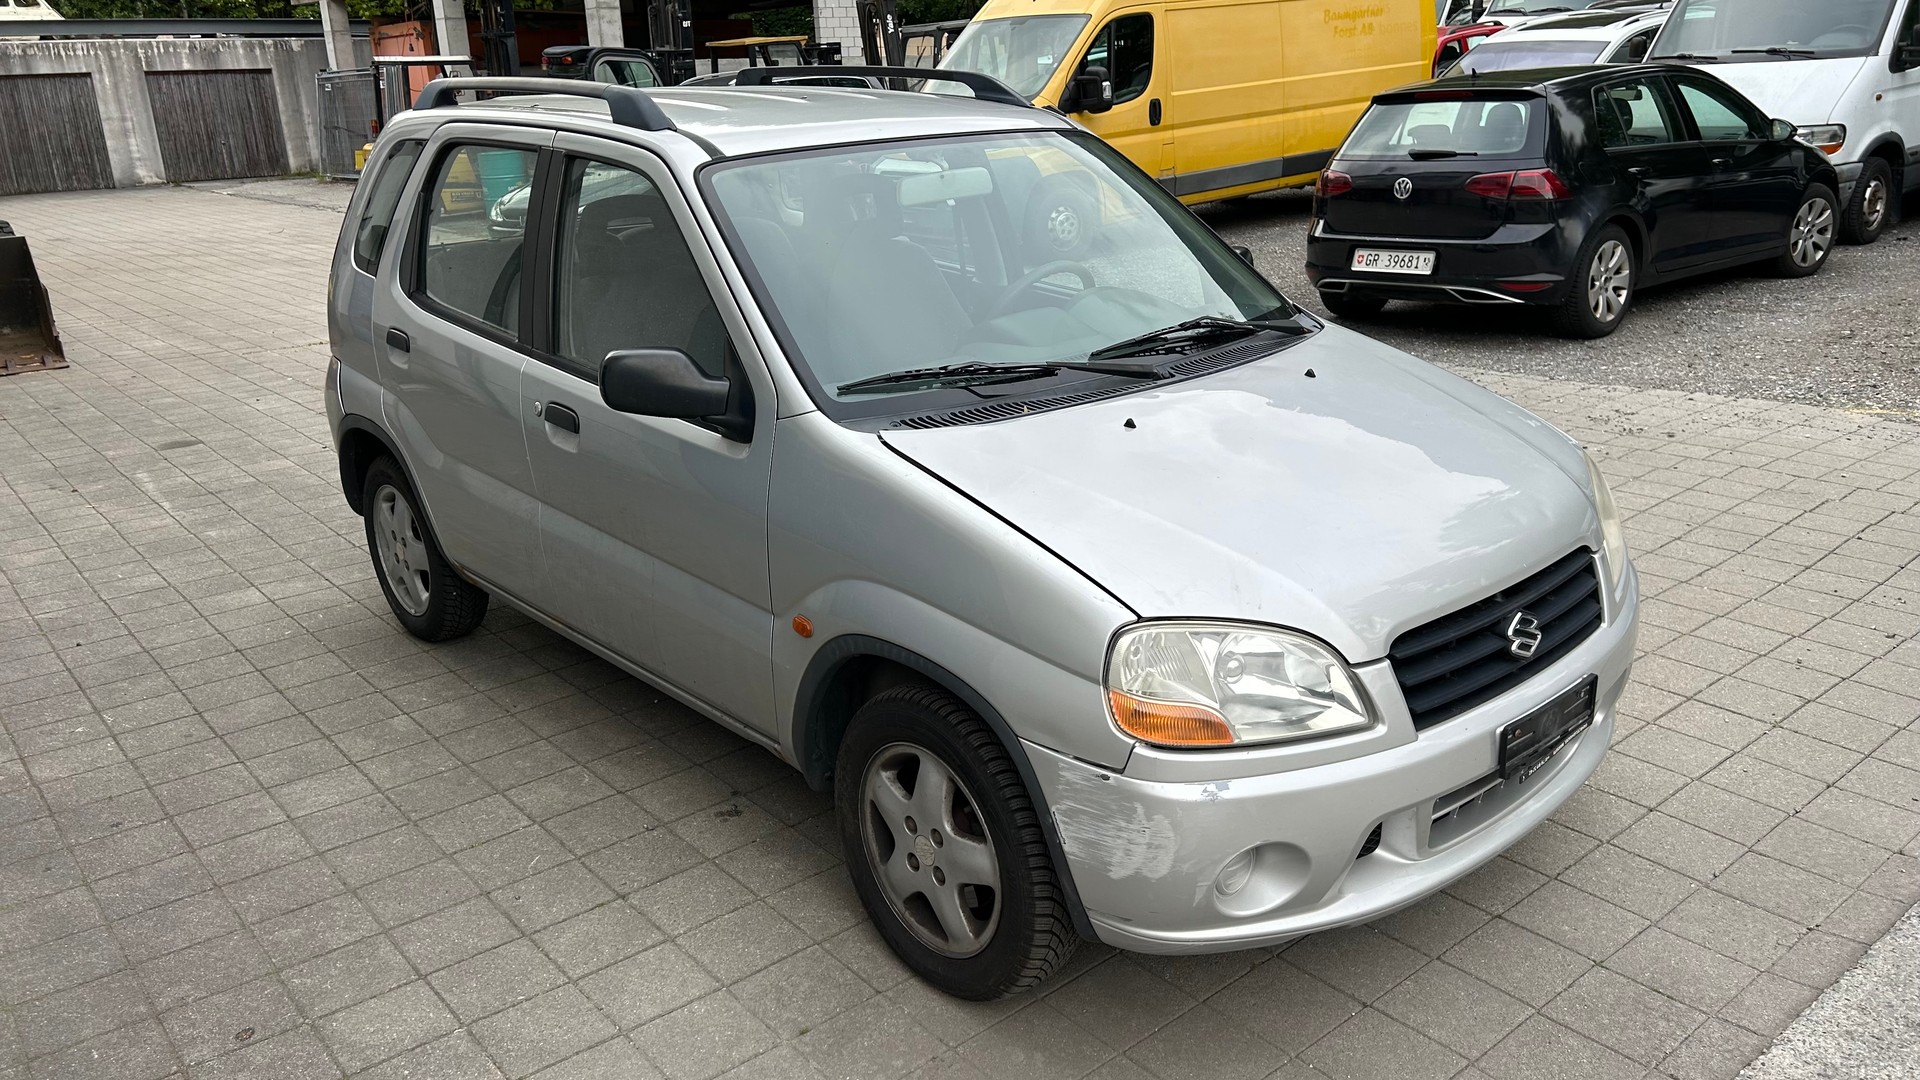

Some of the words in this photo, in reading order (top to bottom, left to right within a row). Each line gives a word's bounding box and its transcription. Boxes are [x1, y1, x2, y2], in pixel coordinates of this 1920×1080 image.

[886, 13, 895, 34] Yale
[1365, 253, 1380, 267] GR
[1384, 254, 1420, 270] 39681
